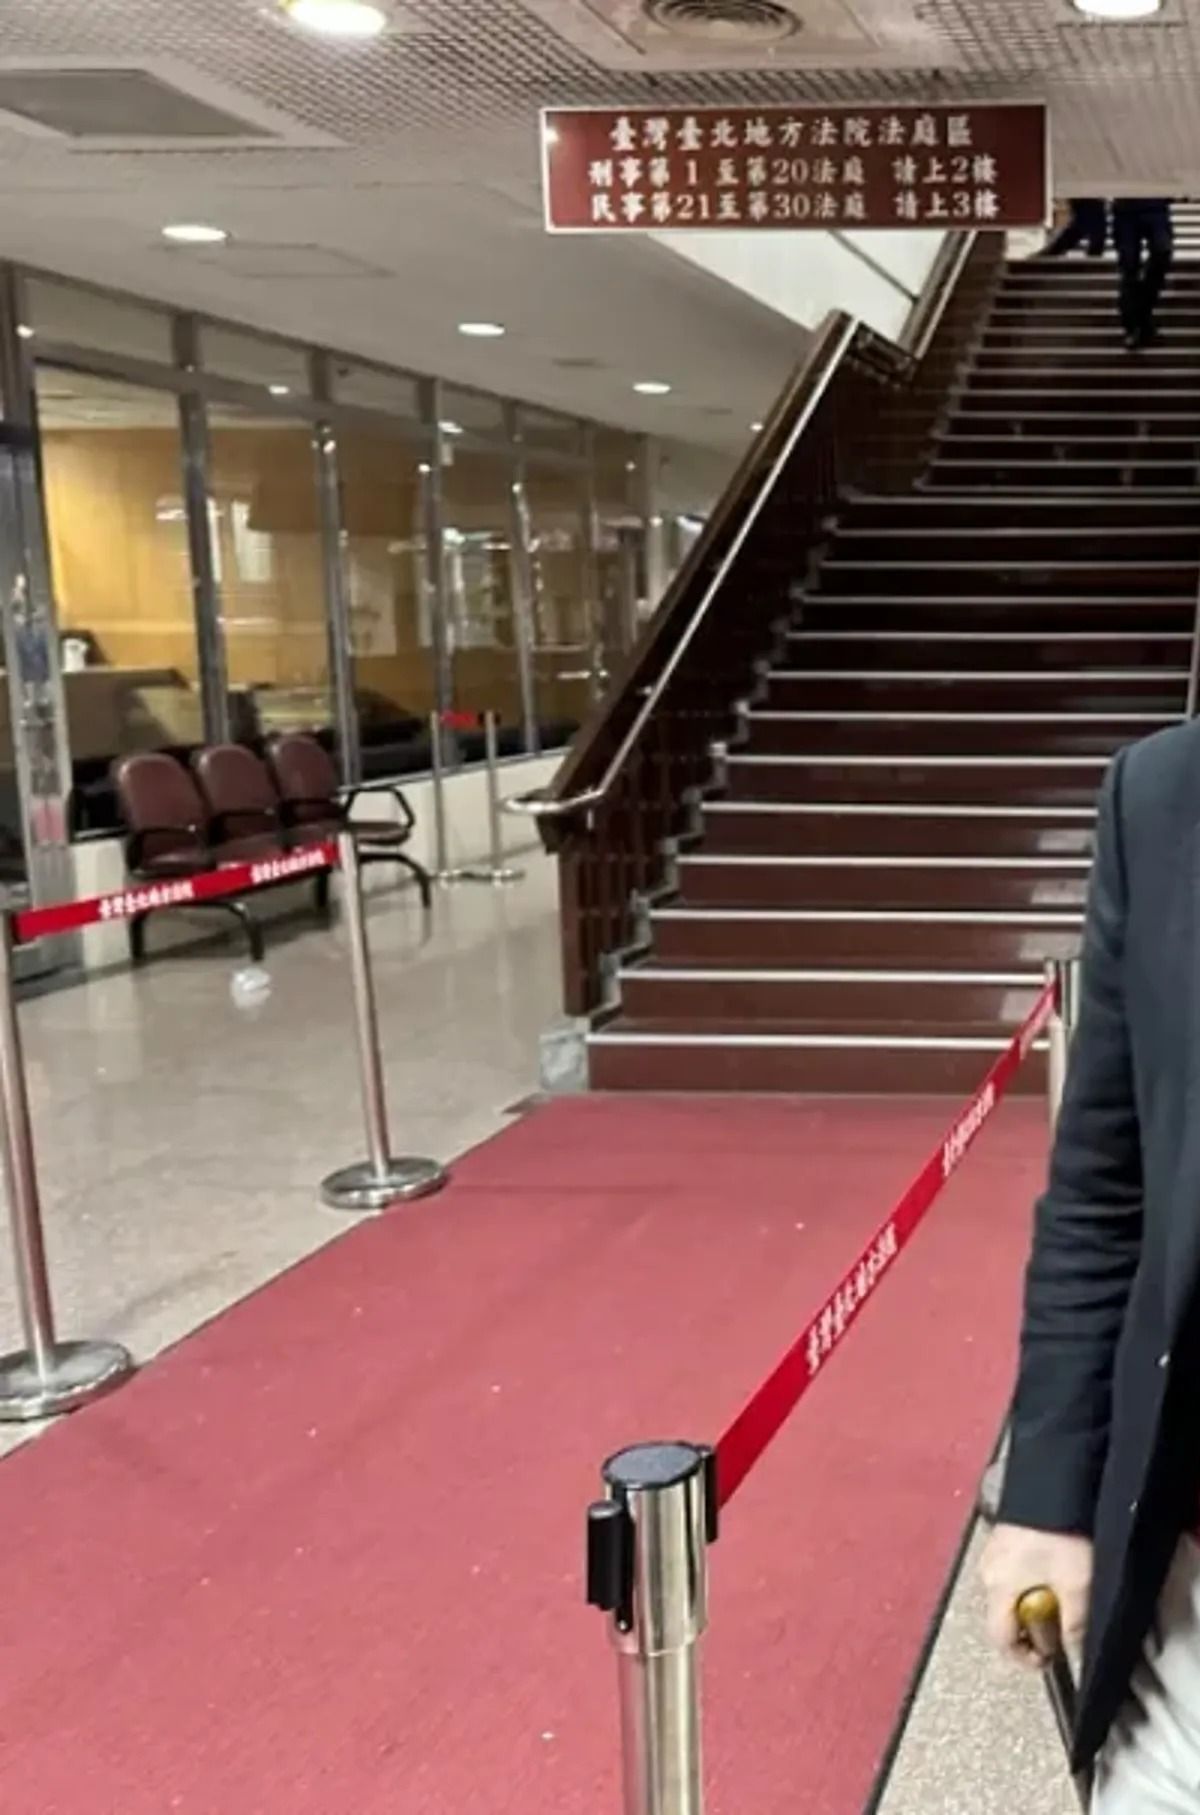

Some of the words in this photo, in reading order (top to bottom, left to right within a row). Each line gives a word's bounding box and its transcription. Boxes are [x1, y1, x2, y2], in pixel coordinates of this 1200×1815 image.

[609, 113, 972, 151] 臺灣臺北地方法院法庭區
